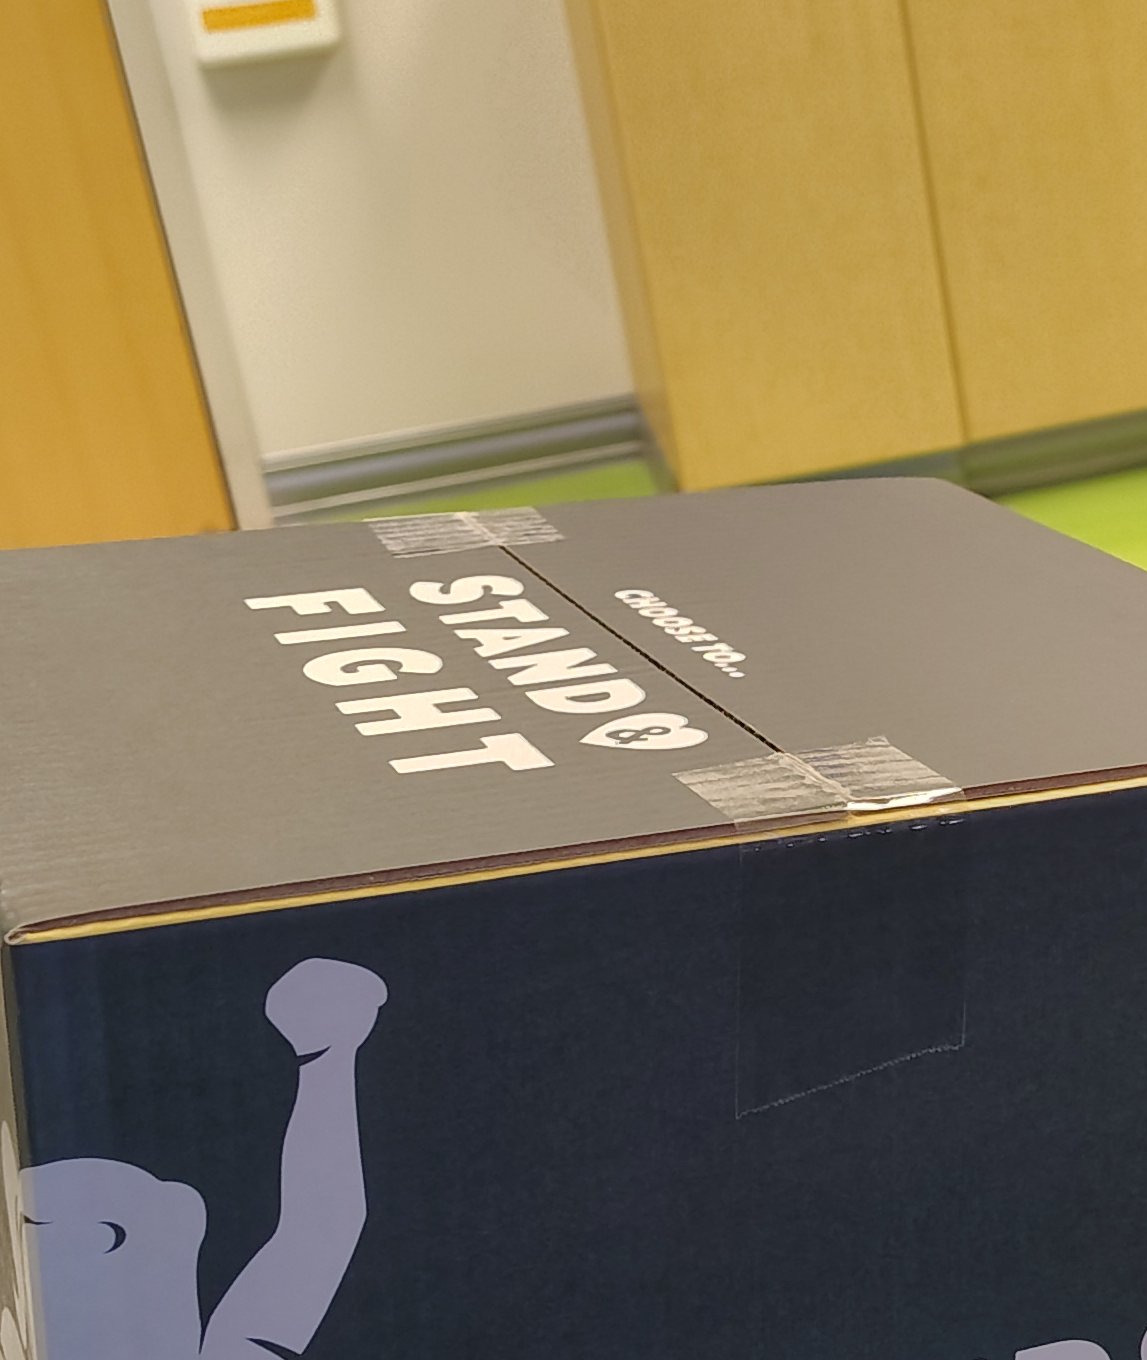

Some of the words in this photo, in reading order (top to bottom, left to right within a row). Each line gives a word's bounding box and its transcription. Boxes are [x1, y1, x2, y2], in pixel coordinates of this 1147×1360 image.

[243, 587, 555, 774] FIGHT
[409, 575, 646, 714] STAND
[605, 725, 672, 745] &
[614, 589, 719, 643] CHOOSE
